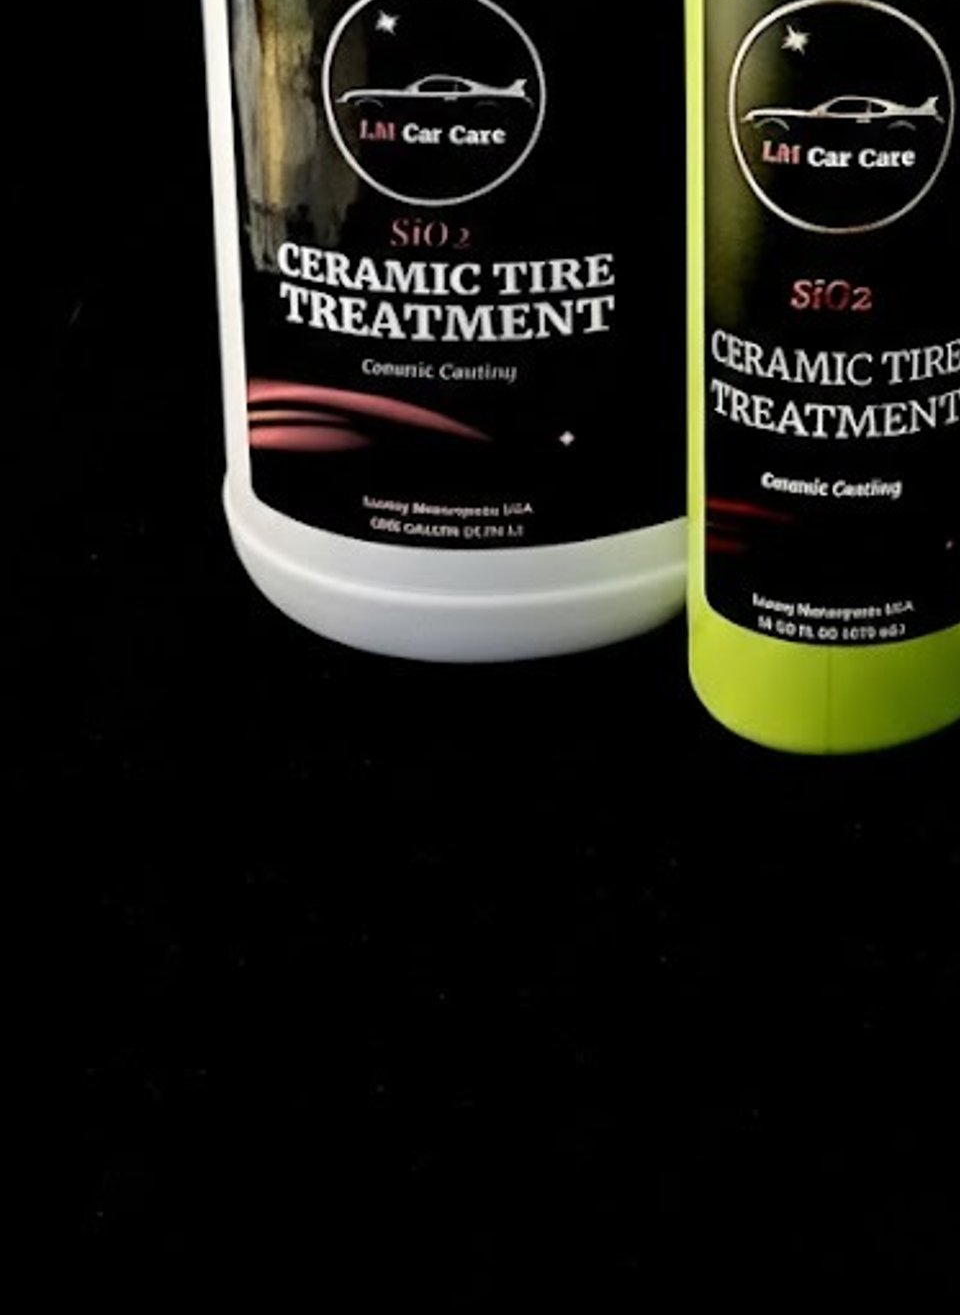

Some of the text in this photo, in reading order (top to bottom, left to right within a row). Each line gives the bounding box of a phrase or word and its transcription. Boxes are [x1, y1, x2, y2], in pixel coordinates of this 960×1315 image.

[359, 119, 507, 145] LM Car Care
[762, 139, 916, 169] LM Car Care
[277, 242, 616, 295] CERAMIC TIRE
[279, 282, 616, 342] TREATMENT
[710, 329, 874, 387] CERAMIC
